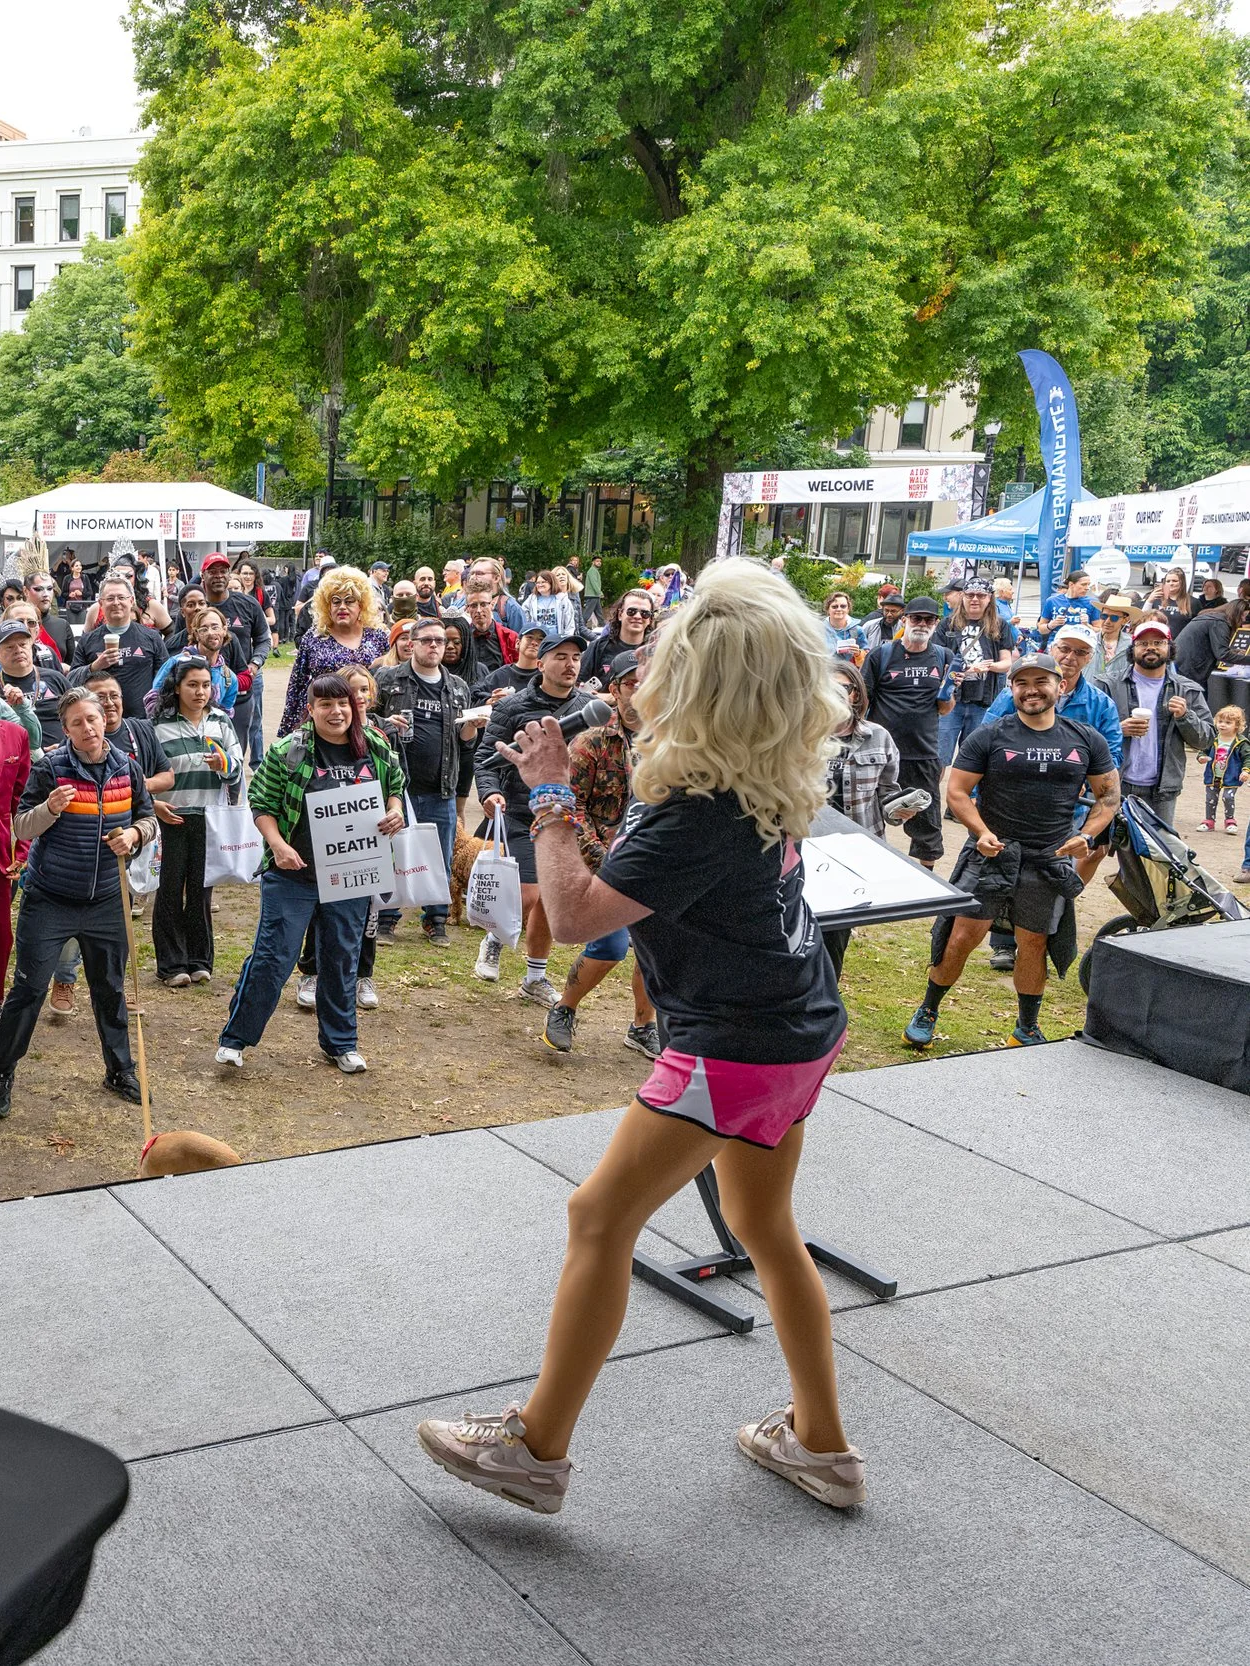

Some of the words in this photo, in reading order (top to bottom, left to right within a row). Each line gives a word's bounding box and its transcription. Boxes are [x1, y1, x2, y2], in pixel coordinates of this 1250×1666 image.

[909, 476, 928, 484] WALK
[808, 479, 874, 492] WELCOME
[66, 518, 154, 530] INFORMATION
[226, 521, 264, 530] T-SHIRTS
[958, 543, 976, 552] KAISER
[1124, 545, 1148, 555] AISER
[905, 669, 928, 678] LIFE
[417, 701, 442, 712] LIFE
[1026, 751, 1063, 761] LIFE
[314, 796, 379, 819] SILENCE
[345, 824, 354, 832] =
[325, 836, 378, 856] DEATH
[343, 872, 380, 889] LIFE
